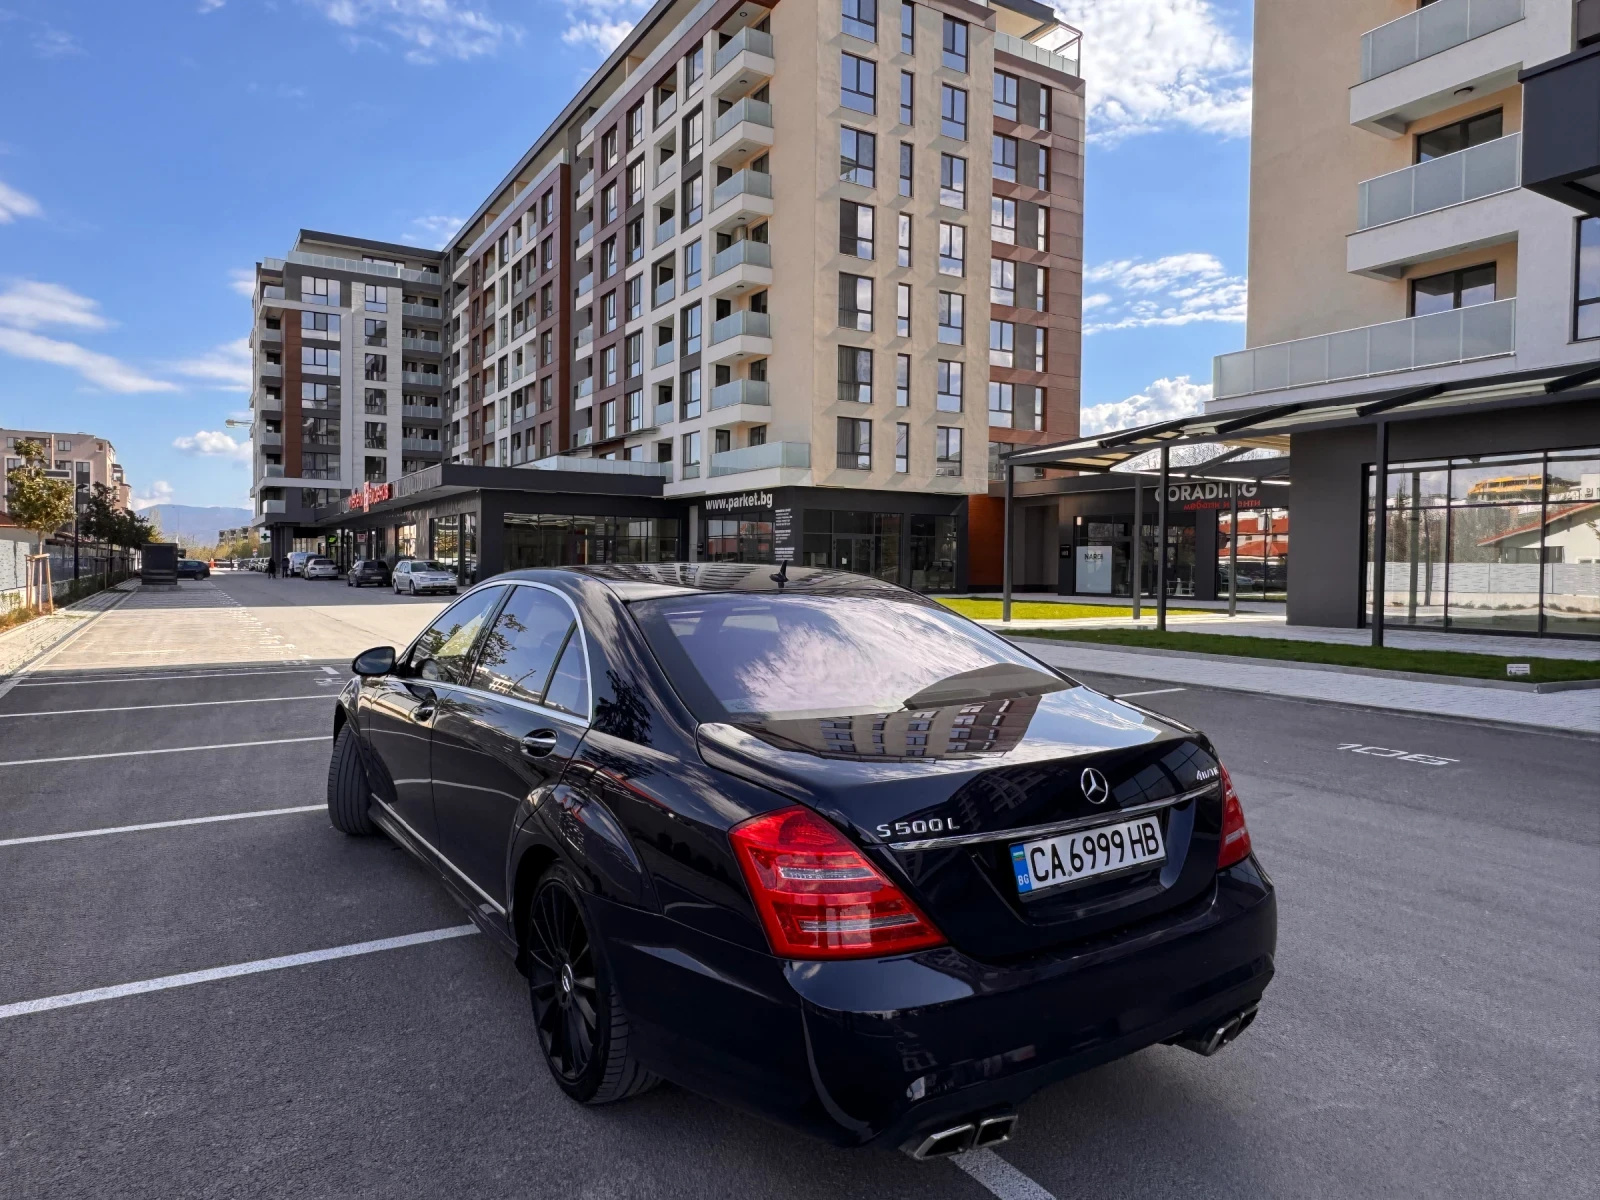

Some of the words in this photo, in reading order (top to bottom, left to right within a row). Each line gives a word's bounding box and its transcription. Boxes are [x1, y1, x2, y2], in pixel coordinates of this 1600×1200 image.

[705, 491, 773, 511] www.parket.bg
[1336, 743, 1460, 766] 106
[876, 824, 891, 838] S
[895, 818, 943, 835] 500
[947, 817, 960, 829] L
[1030, 843, 1067, 882] CA
[1069, 829, 1124, 872] 6999
[1127, 822, 1159, 858] HB
[1018, 875, 1030, 885] BG
